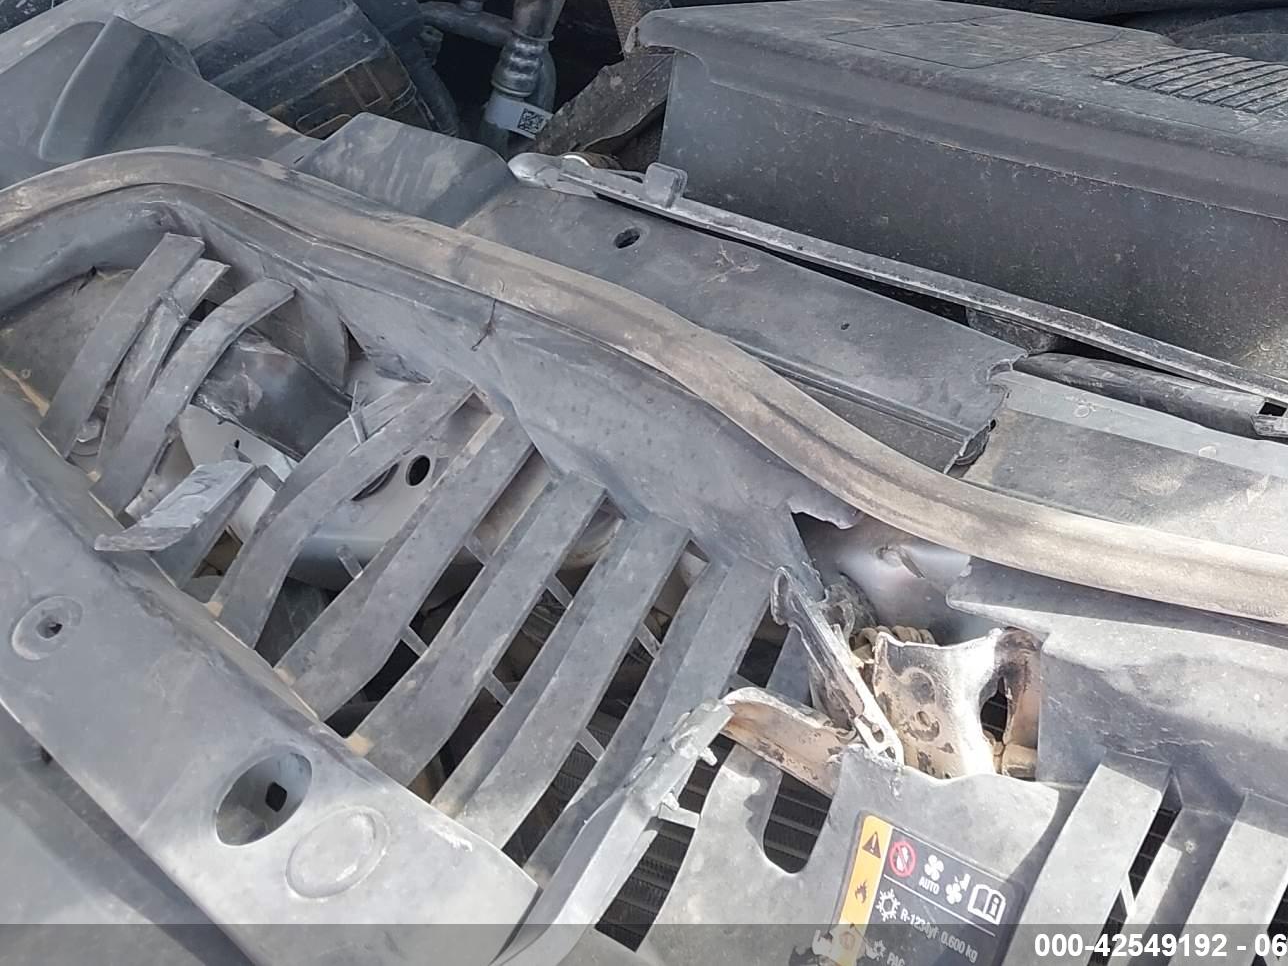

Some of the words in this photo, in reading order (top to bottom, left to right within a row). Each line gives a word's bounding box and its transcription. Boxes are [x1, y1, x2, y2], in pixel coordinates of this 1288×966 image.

[918, 876, 940, 895] AUTO
[941, 931, 966, 955] 0.600
[965, 944, 979, 964] kg
